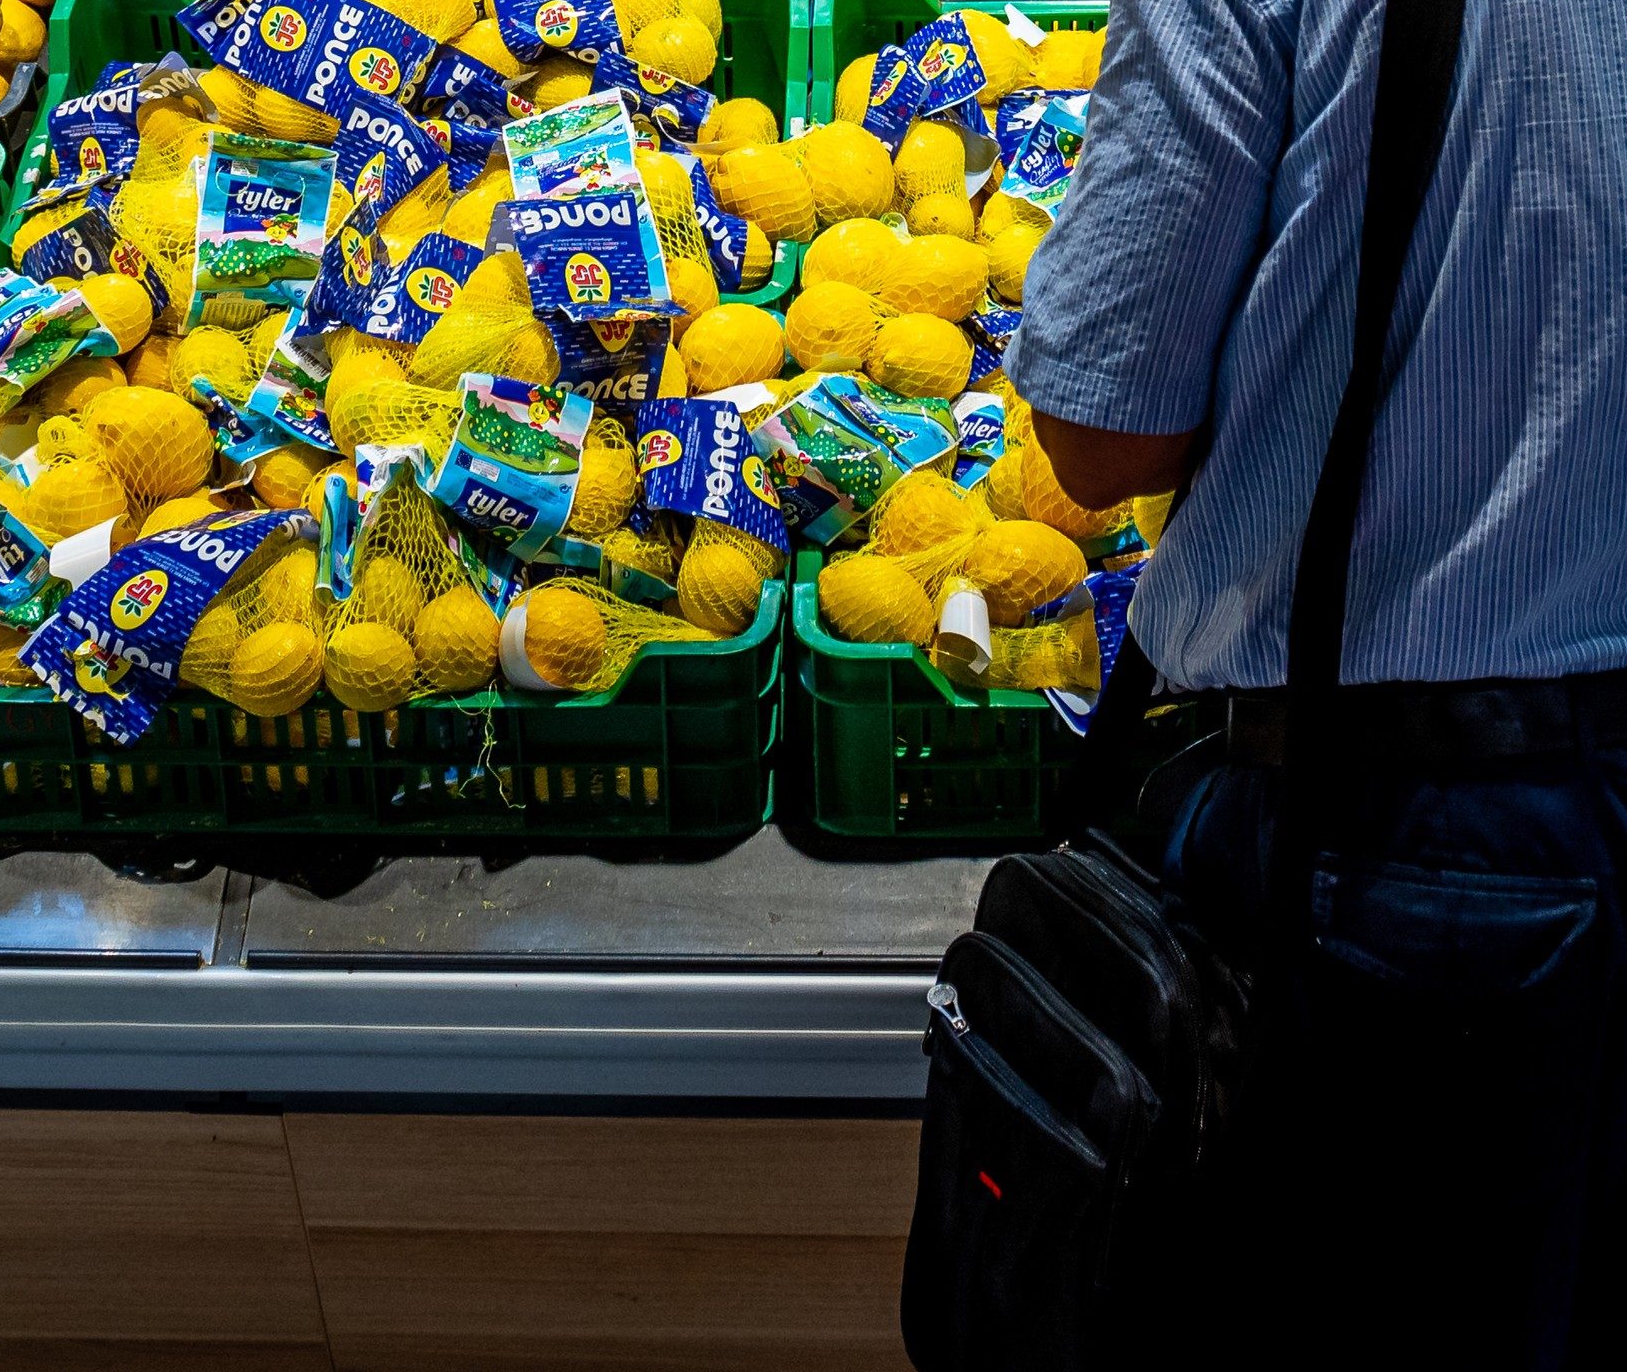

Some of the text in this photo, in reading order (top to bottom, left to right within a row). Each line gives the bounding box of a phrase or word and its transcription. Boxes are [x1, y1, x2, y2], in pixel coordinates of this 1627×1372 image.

[305, 3, 365, 107] PONCE
[347, 107, 424, 175] PONCE
[1021, 126, 1054, 174] tyler
[235, 186, 296, 213] tyler
[522, 199, 633, 235] PONCE
[702, 410, 742, 518] PONCE
[467, 487, 529, 527] tyler
[149, 528, 245, 573] PONCE
